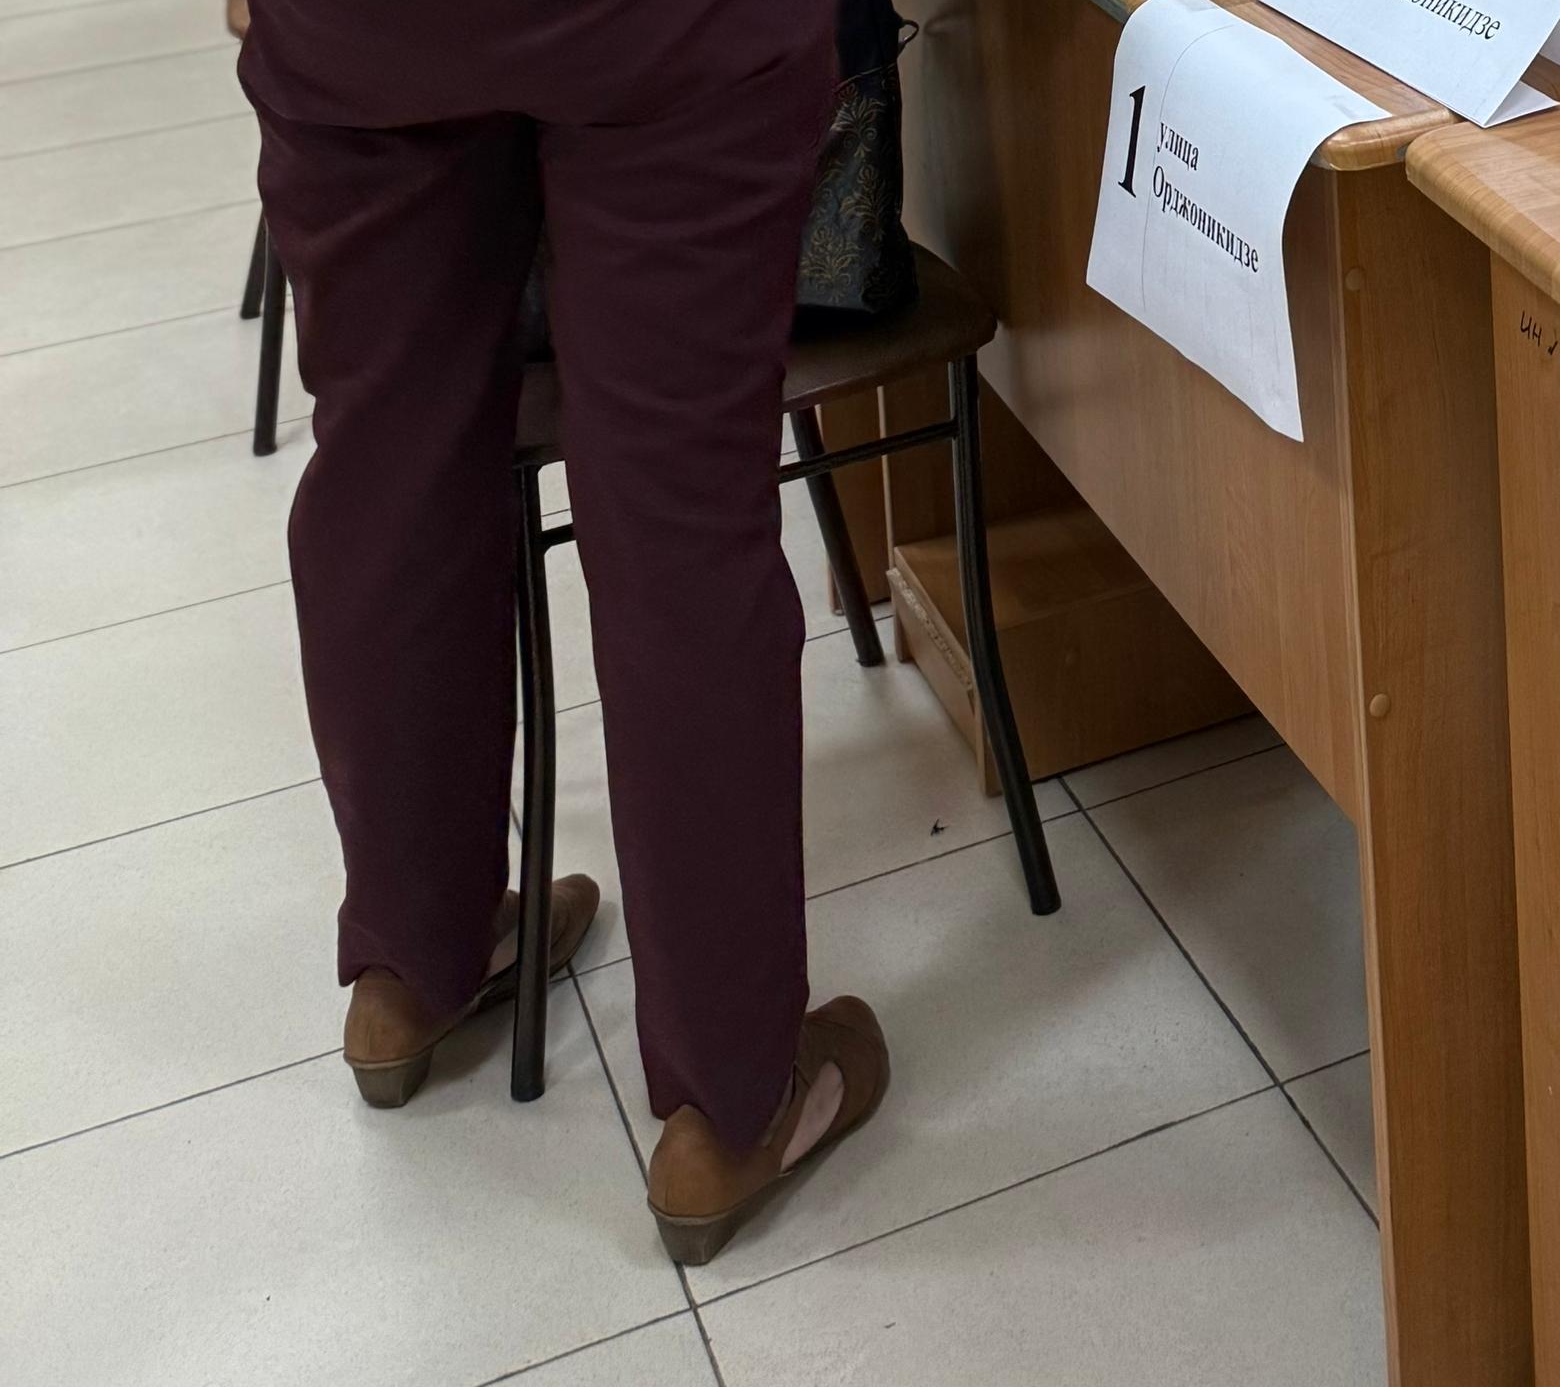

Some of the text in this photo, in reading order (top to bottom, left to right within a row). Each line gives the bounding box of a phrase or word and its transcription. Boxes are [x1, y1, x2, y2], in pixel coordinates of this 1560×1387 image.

[1118, 85, 1146, 198] 1
[1157, 122, 1199, 171] улица
[1153, 166, 1259, 273] Орджоникидзе
